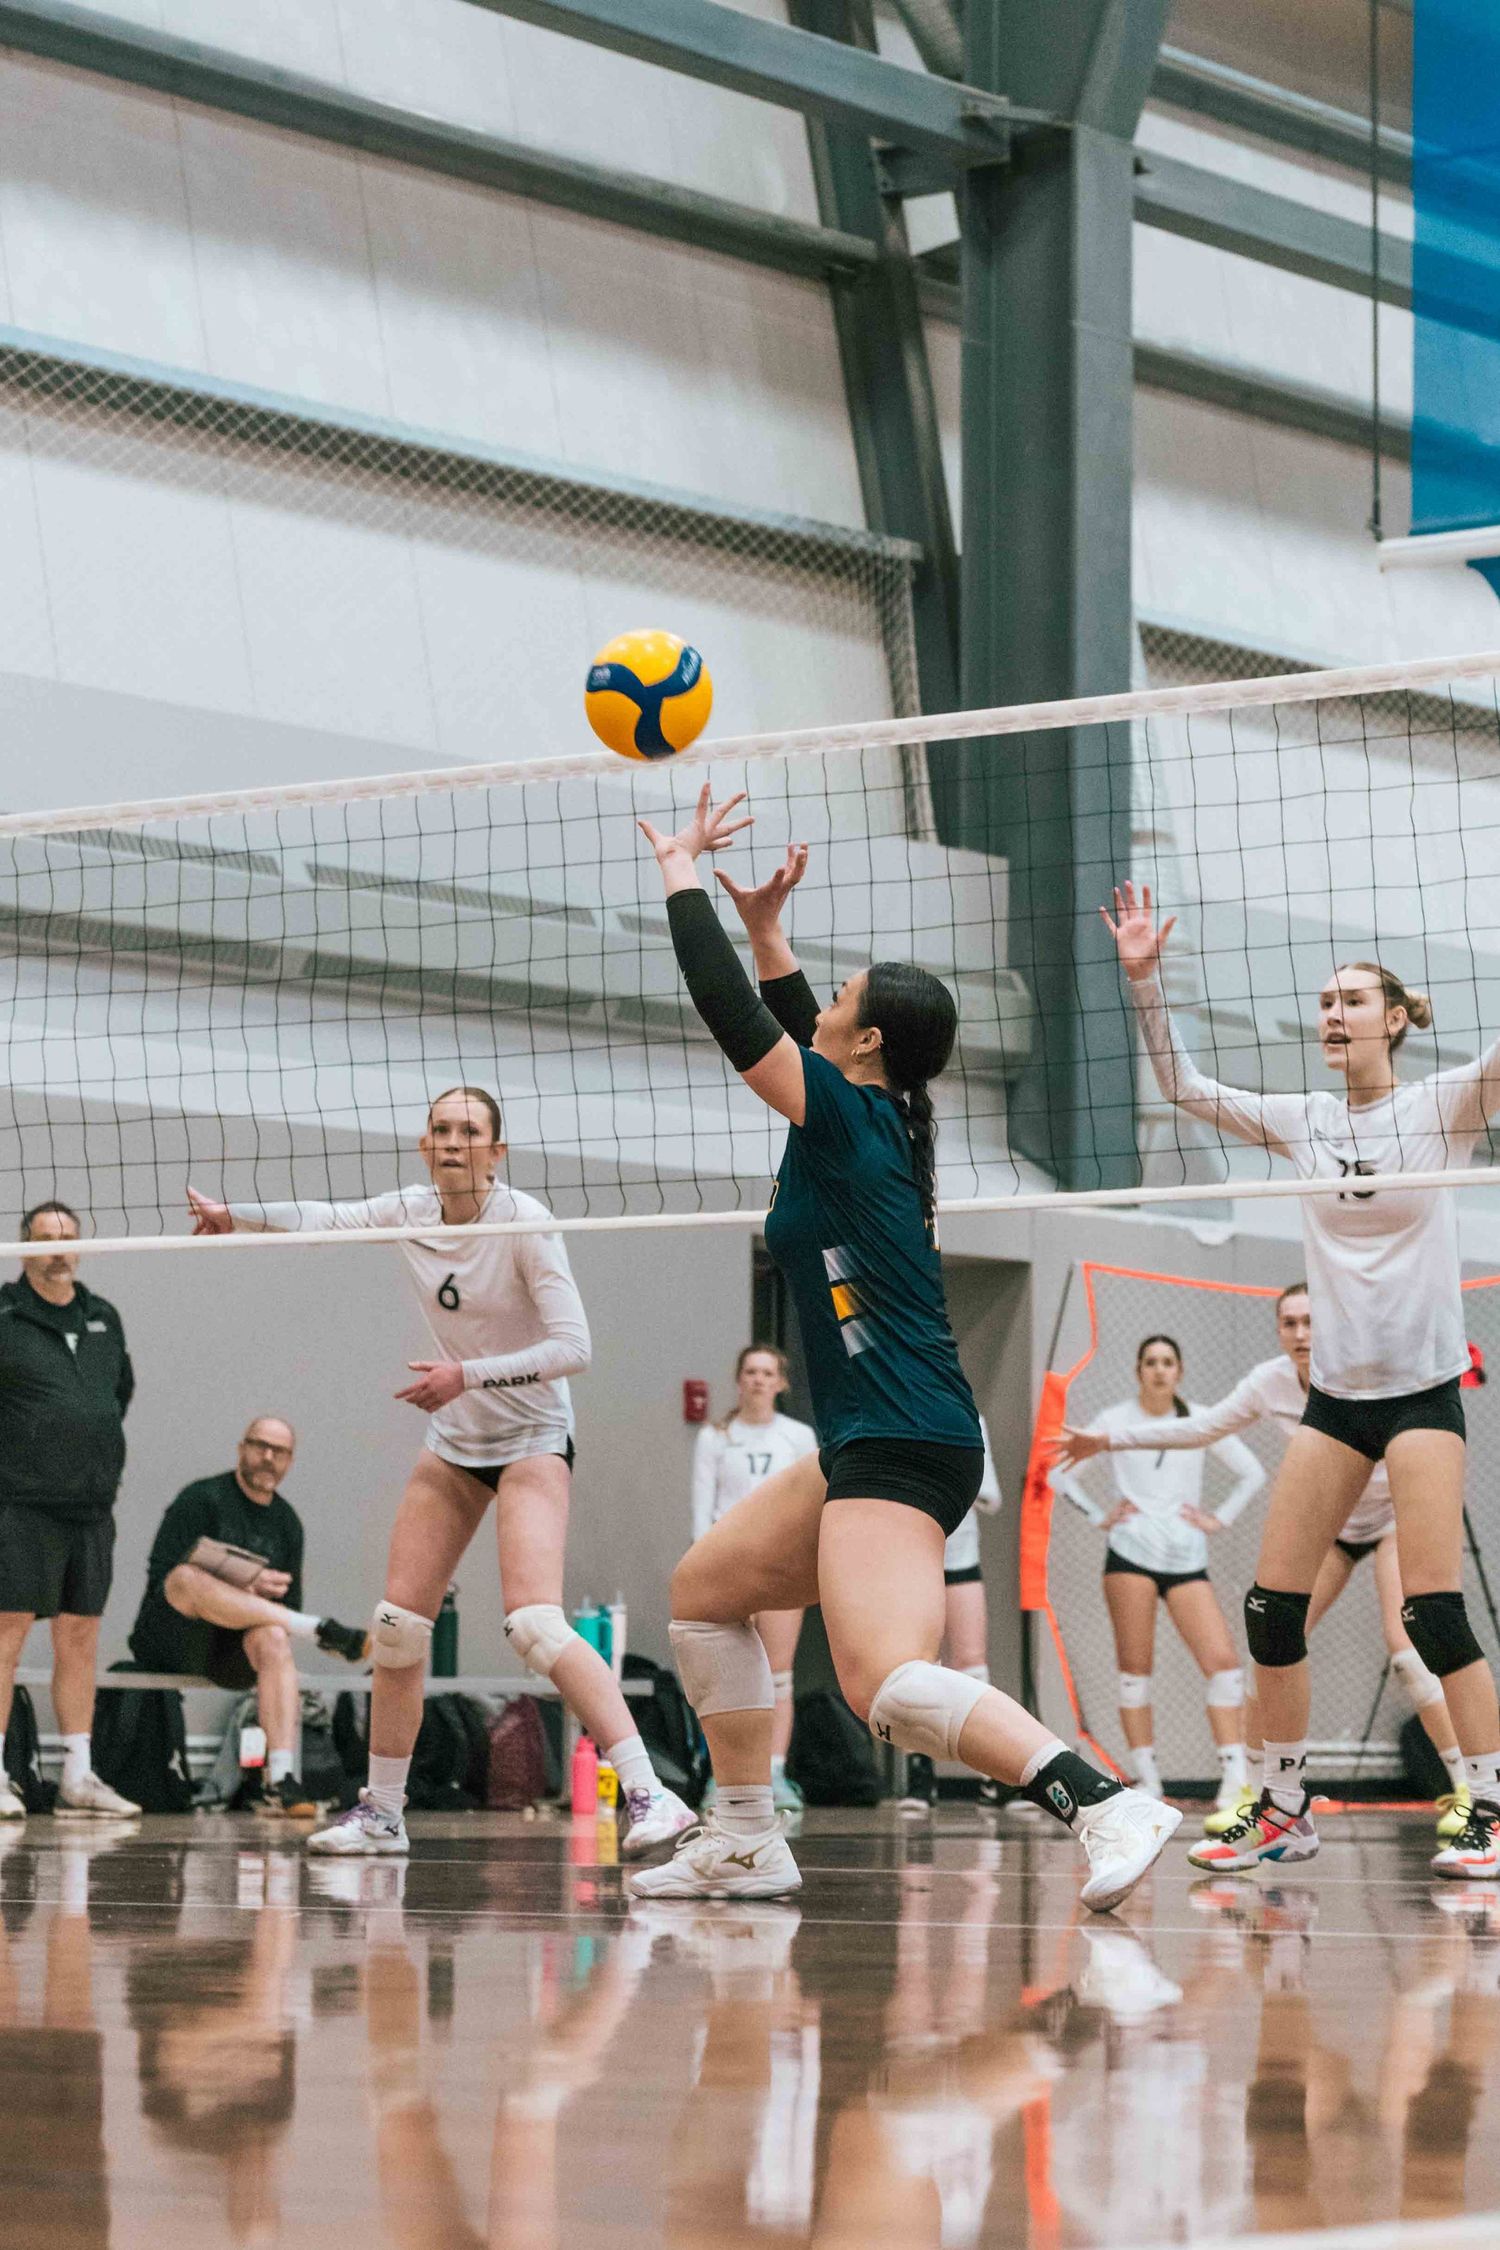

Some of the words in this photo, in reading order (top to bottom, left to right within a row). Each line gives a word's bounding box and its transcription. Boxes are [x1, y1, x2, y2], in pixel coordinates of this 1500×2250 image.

[1338, 1159, 1378, 1200] 15
[438, 1273, 460, 1311] 6
[483, 1372, 540, 1388] PARK
[747, 1453, 772, 1475] 17
